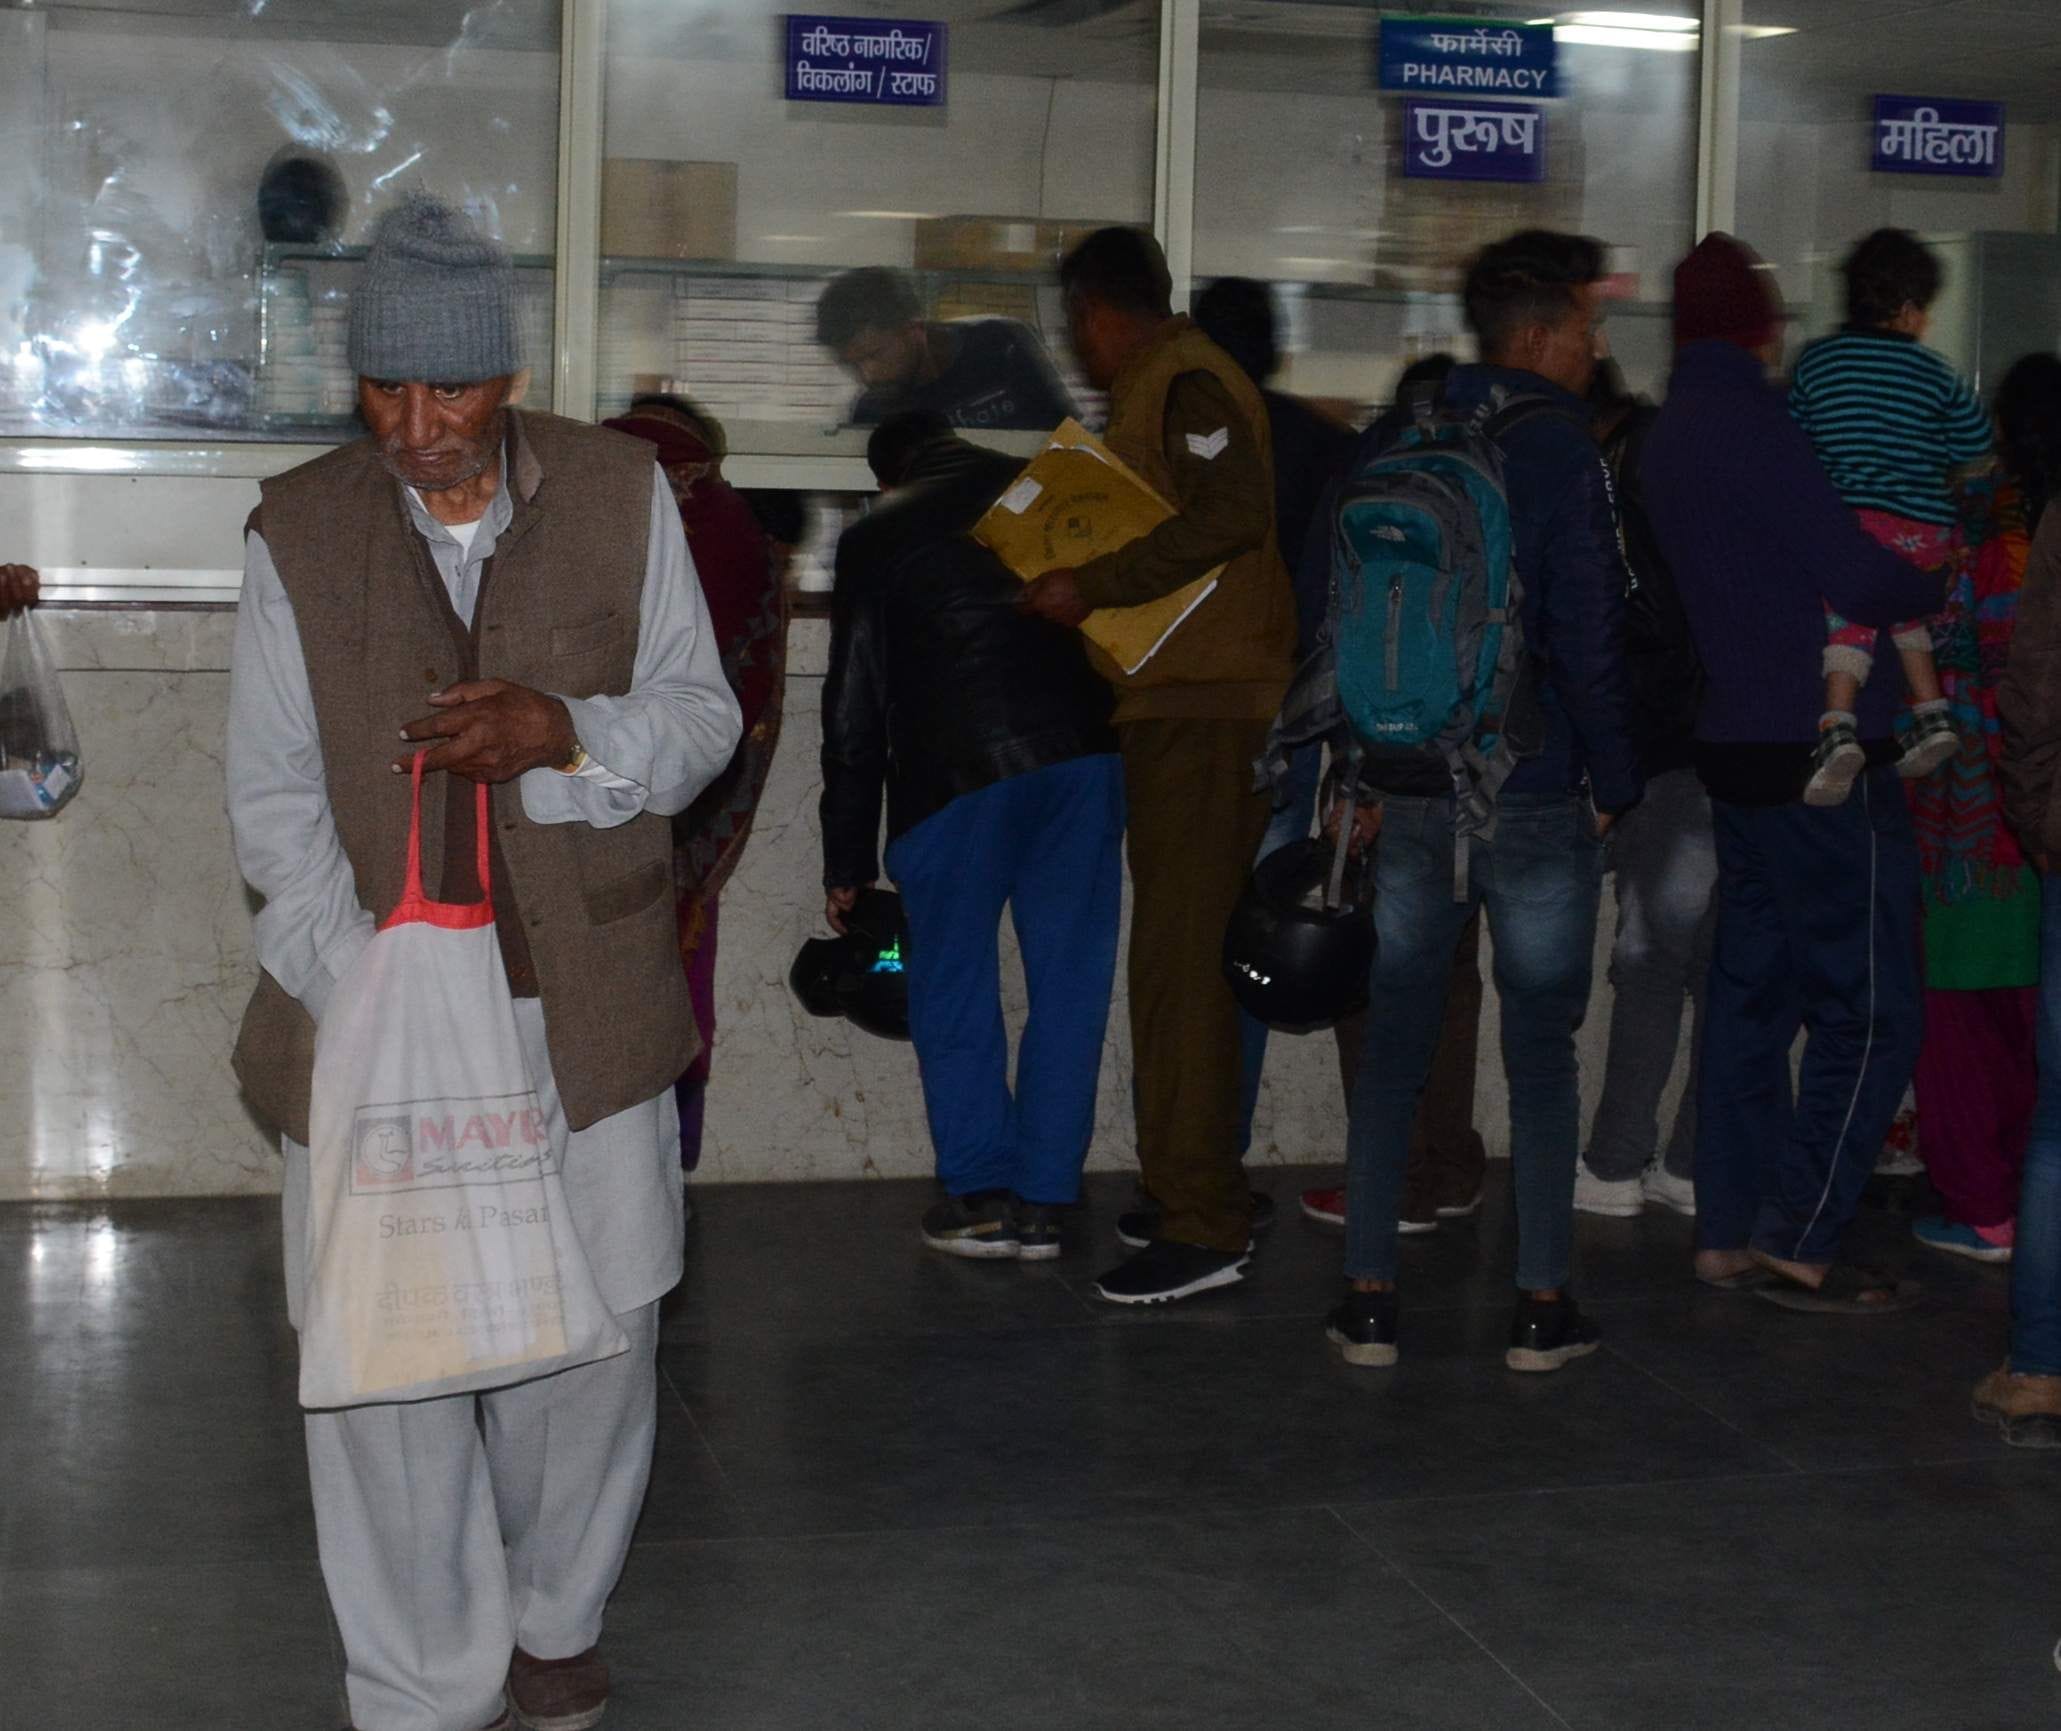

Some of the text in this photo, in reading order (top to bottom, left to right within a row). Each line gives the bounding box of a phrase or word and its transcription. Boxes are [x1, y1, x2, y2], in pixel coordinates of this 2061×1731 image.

[802, 25, 850, 56] वरिष्ठ
[796, 60, 873, 93] विकलांग
[890, 72, 937, 96] स्टाफ
[1403, 63, 1547, 89] PHARMACY
[1880, 106, 1998, 165] महिला
[379, 1214, 447, 1240] Stars
